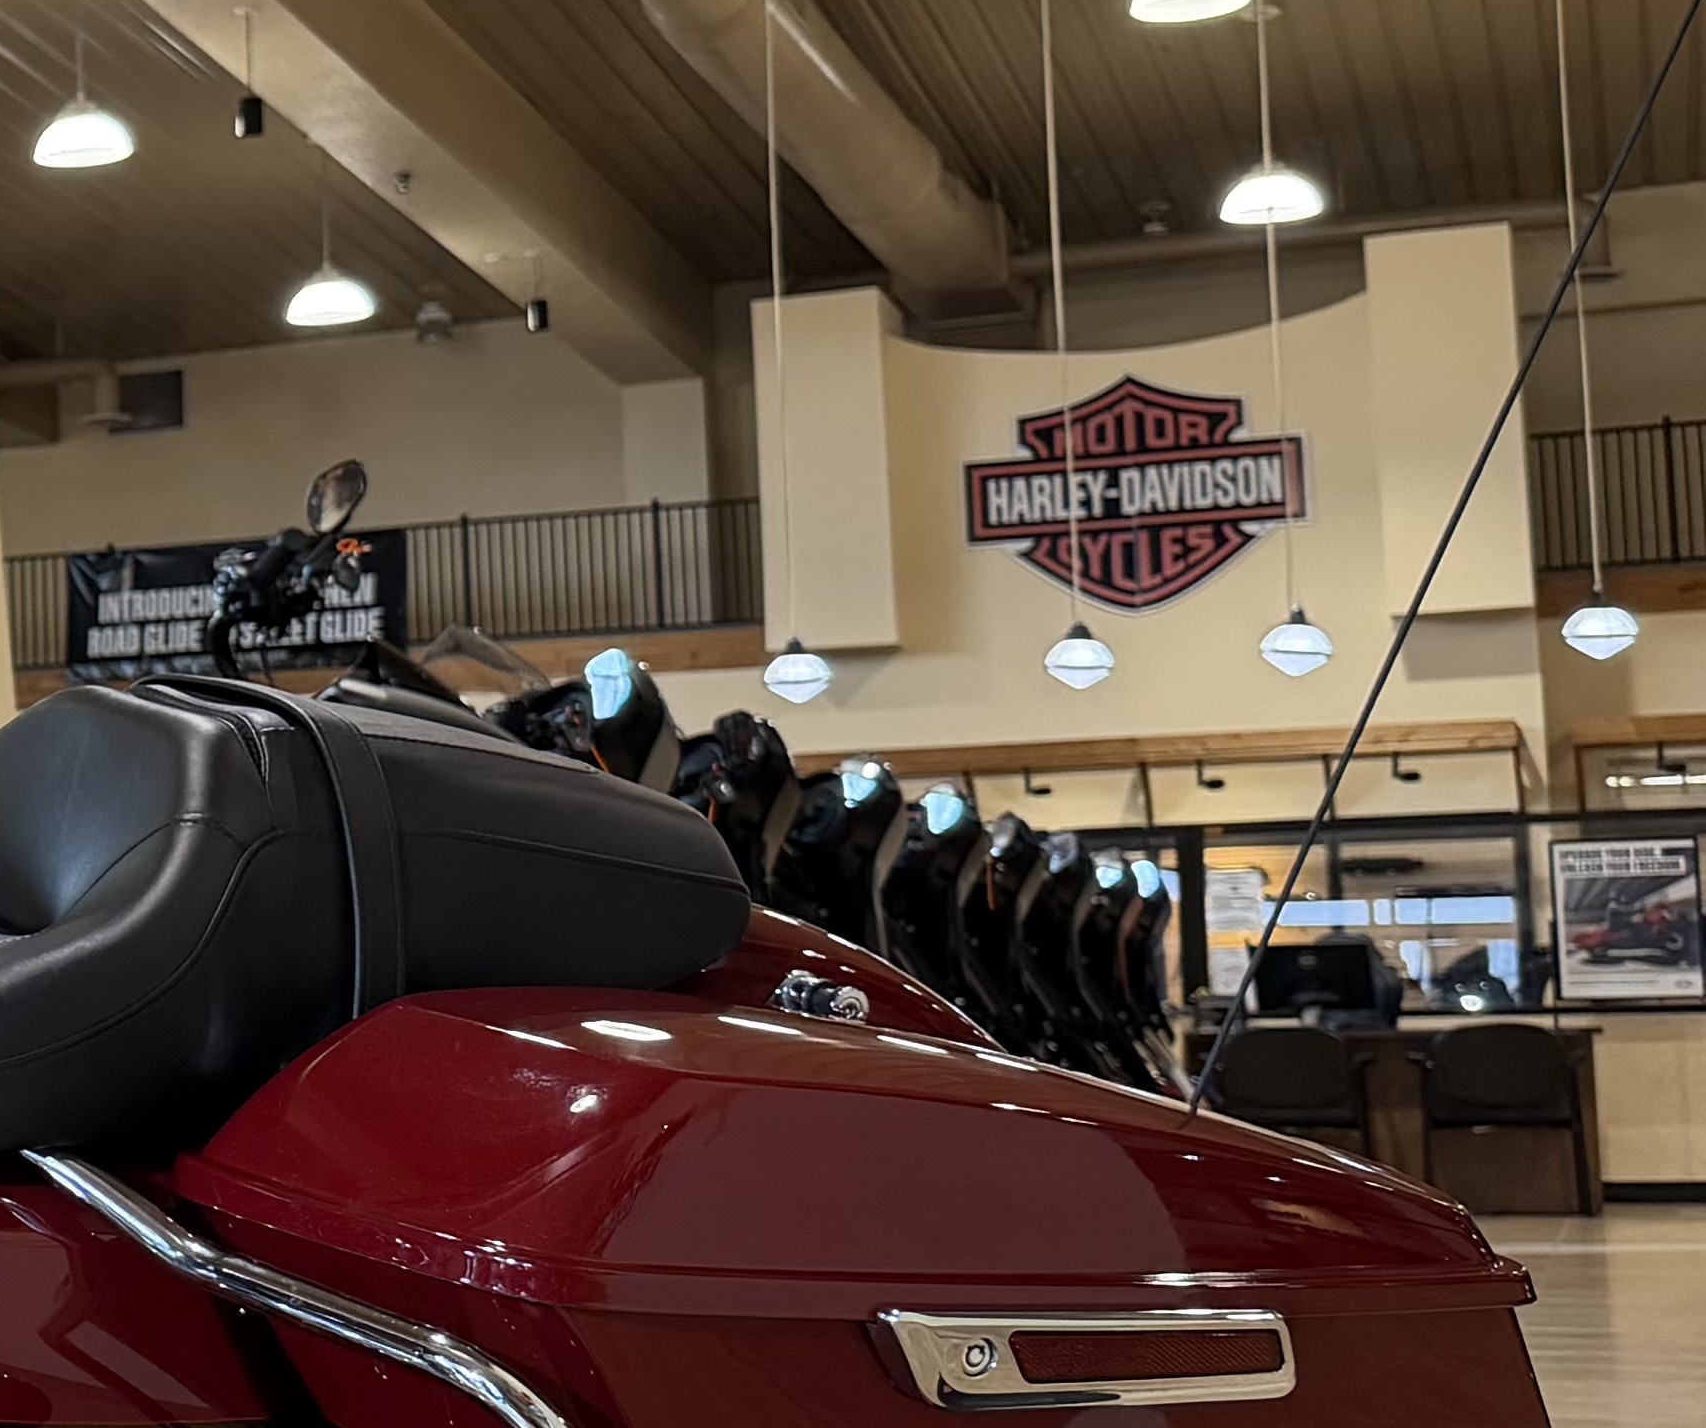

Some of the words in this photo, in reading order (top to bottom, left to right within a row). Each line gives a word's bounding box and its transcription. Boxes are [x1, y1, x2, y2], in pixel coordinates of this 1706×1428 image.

[1053, 398, 1212, 458] MOTOR
[988, 456, 1285, 526] HARLEY-DAVIDSON
[1058, 525, 1215, 592] CYCLES
[87, 624, 140, 659] ROAD
[143, 619, 207, 656] GLIDE
[320, 607, 386, 643] GLIDE
